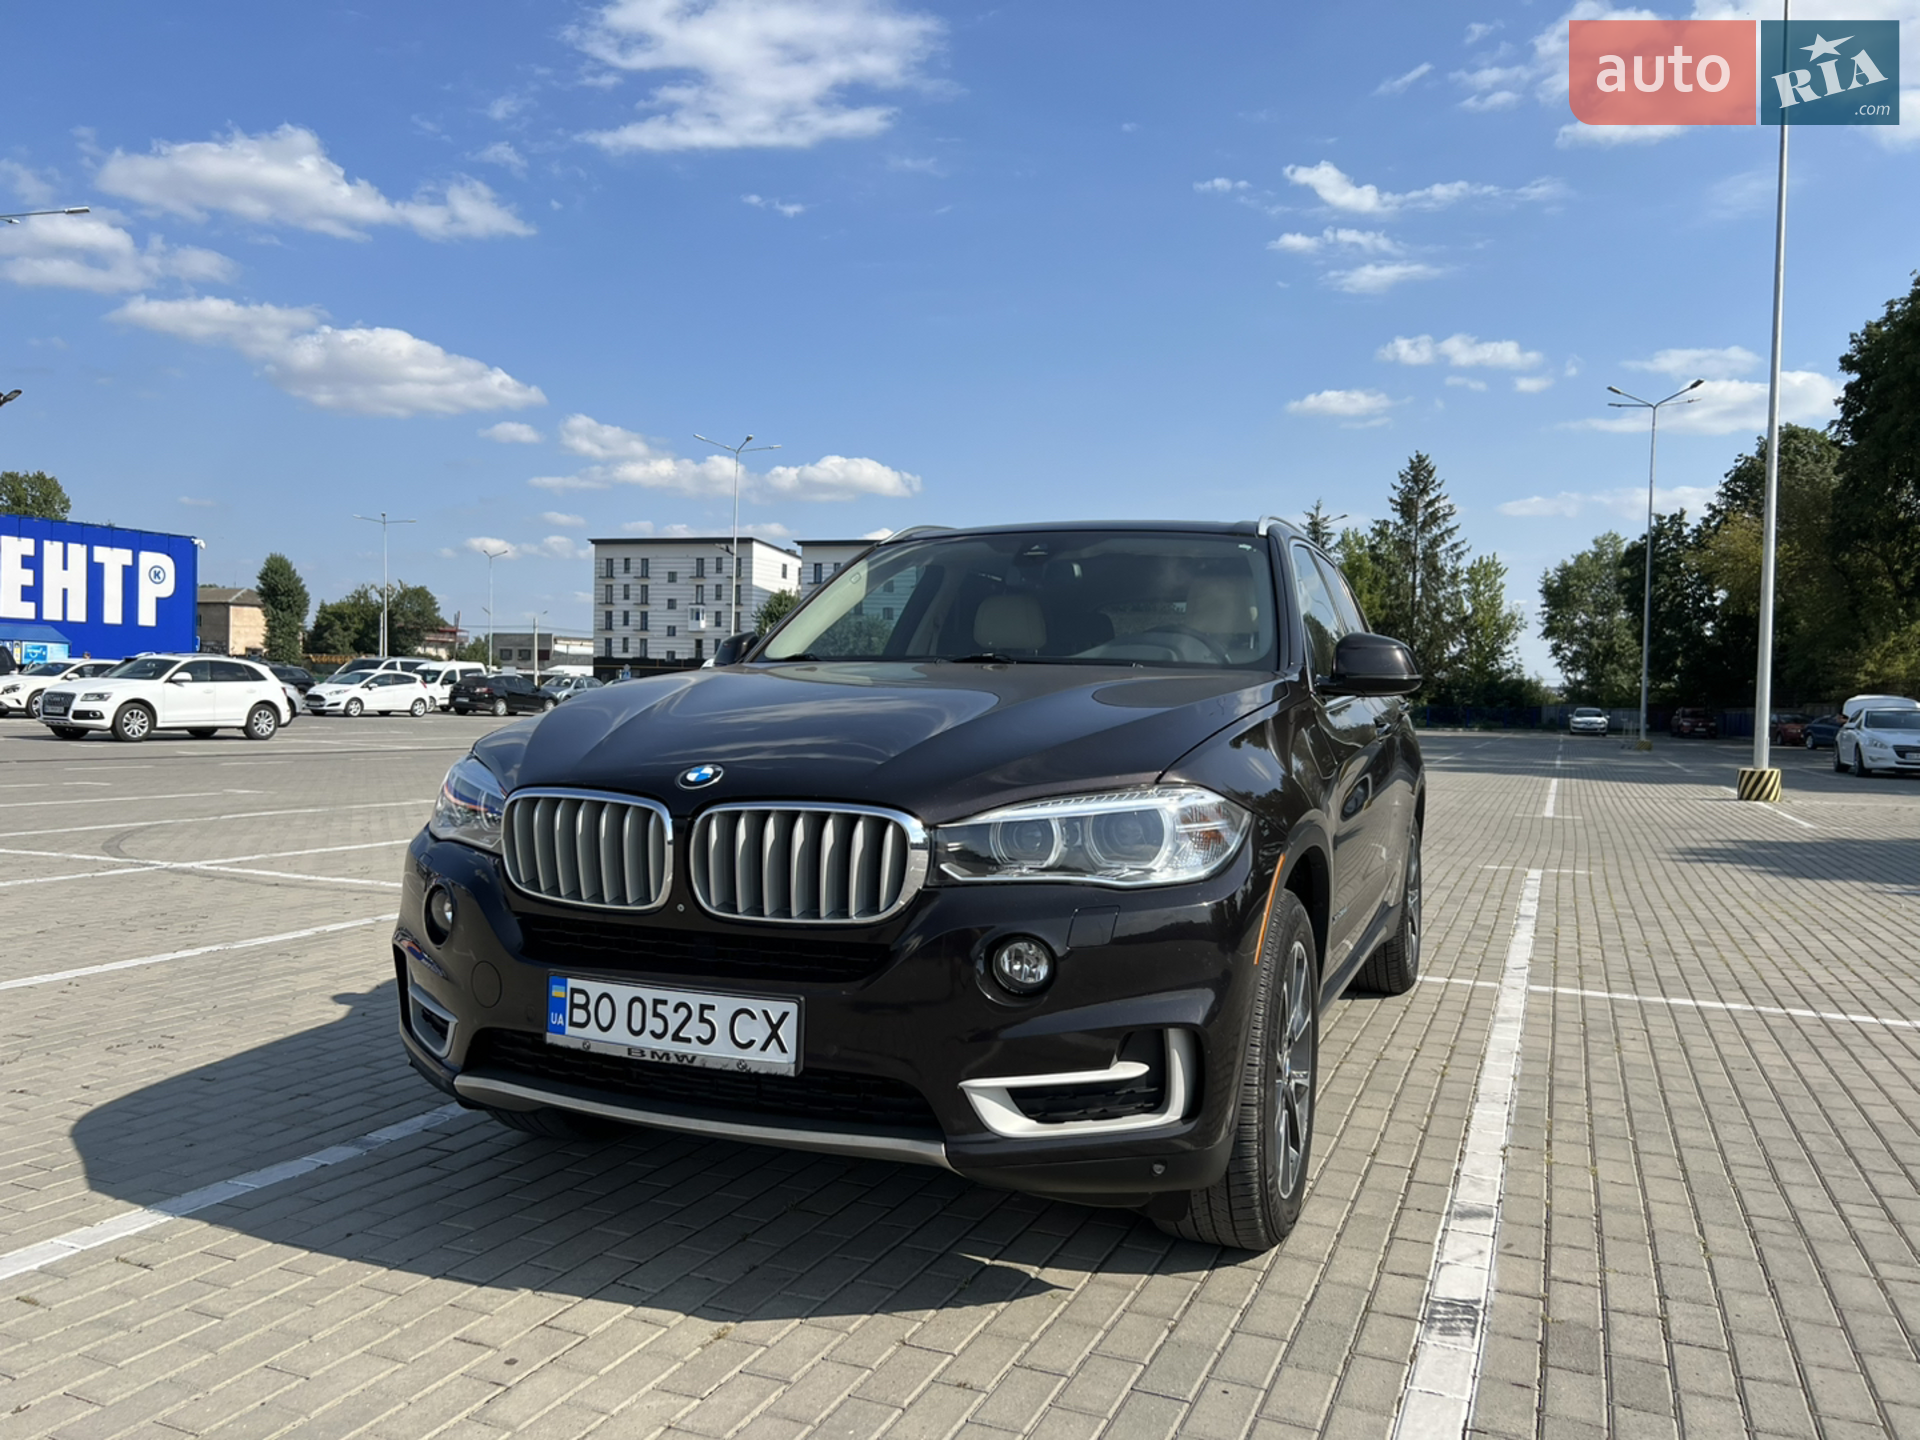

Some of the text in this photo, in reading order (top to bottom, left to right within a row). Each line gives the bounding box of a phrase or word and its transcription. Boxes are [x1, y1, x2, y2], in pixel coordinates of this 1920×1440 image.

[0, 535, 175, 627] ЕНТР
[551, 1012, 564, 1026] UA
[568, 987, 790, 1054] BO 0525 CX
[627, 1047, 697, 1065] BMW
